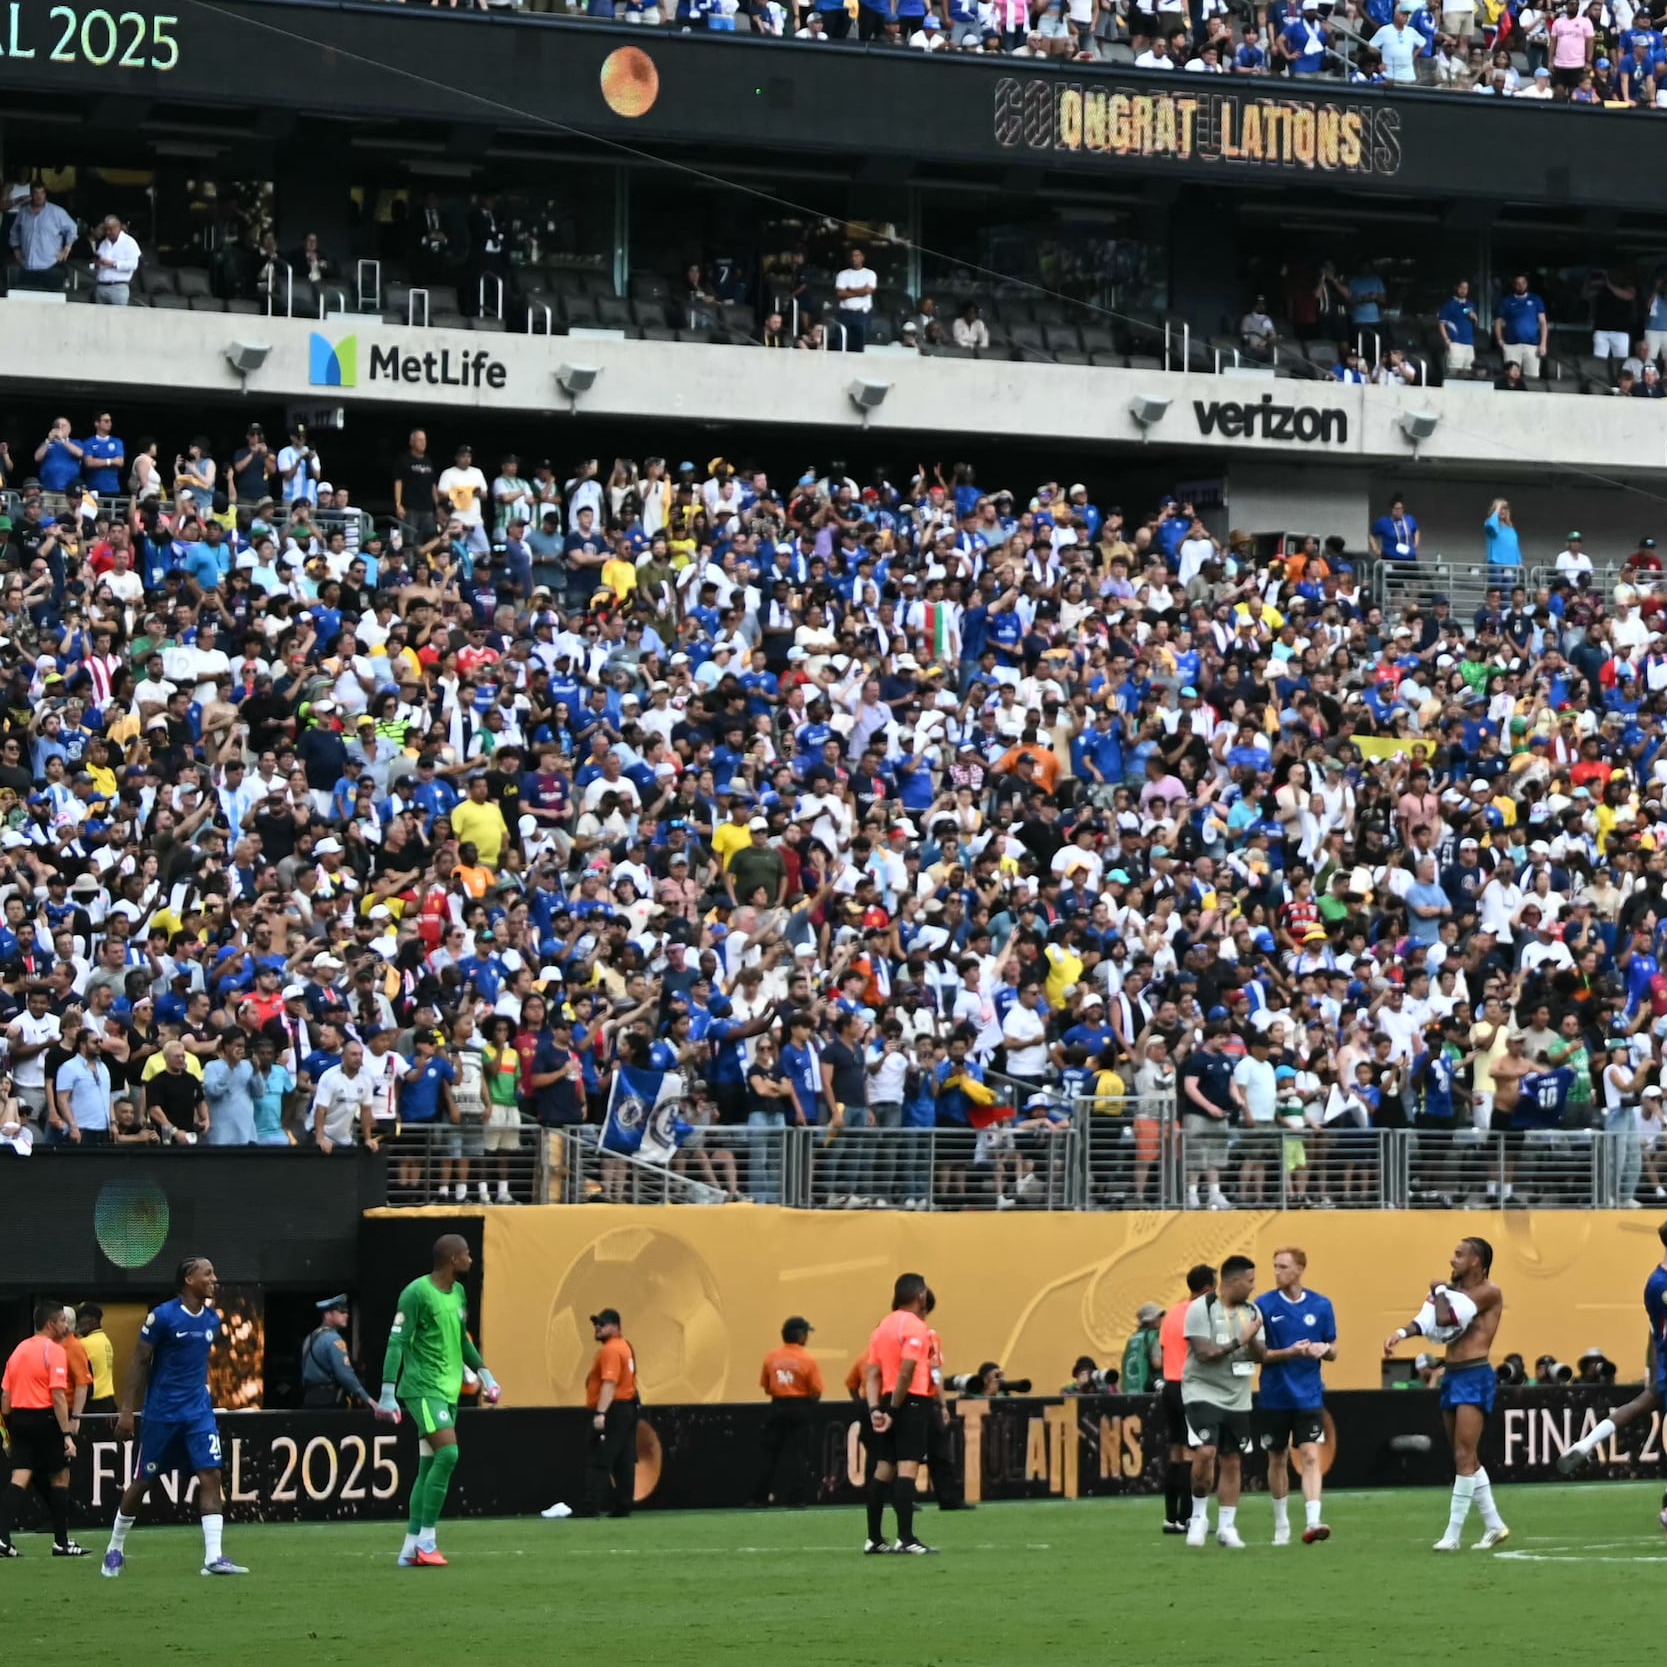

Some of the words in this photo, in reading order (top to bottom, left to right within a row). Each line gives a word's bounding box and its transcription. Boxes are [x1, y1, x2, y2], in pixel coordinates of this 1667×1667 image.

[49, 5, 181, 71] 2025
[369, 343, 508, 390] MetLife
[1193, 392, 1349, 445] verizon
[270, 1435, 400, 1502] 2025
